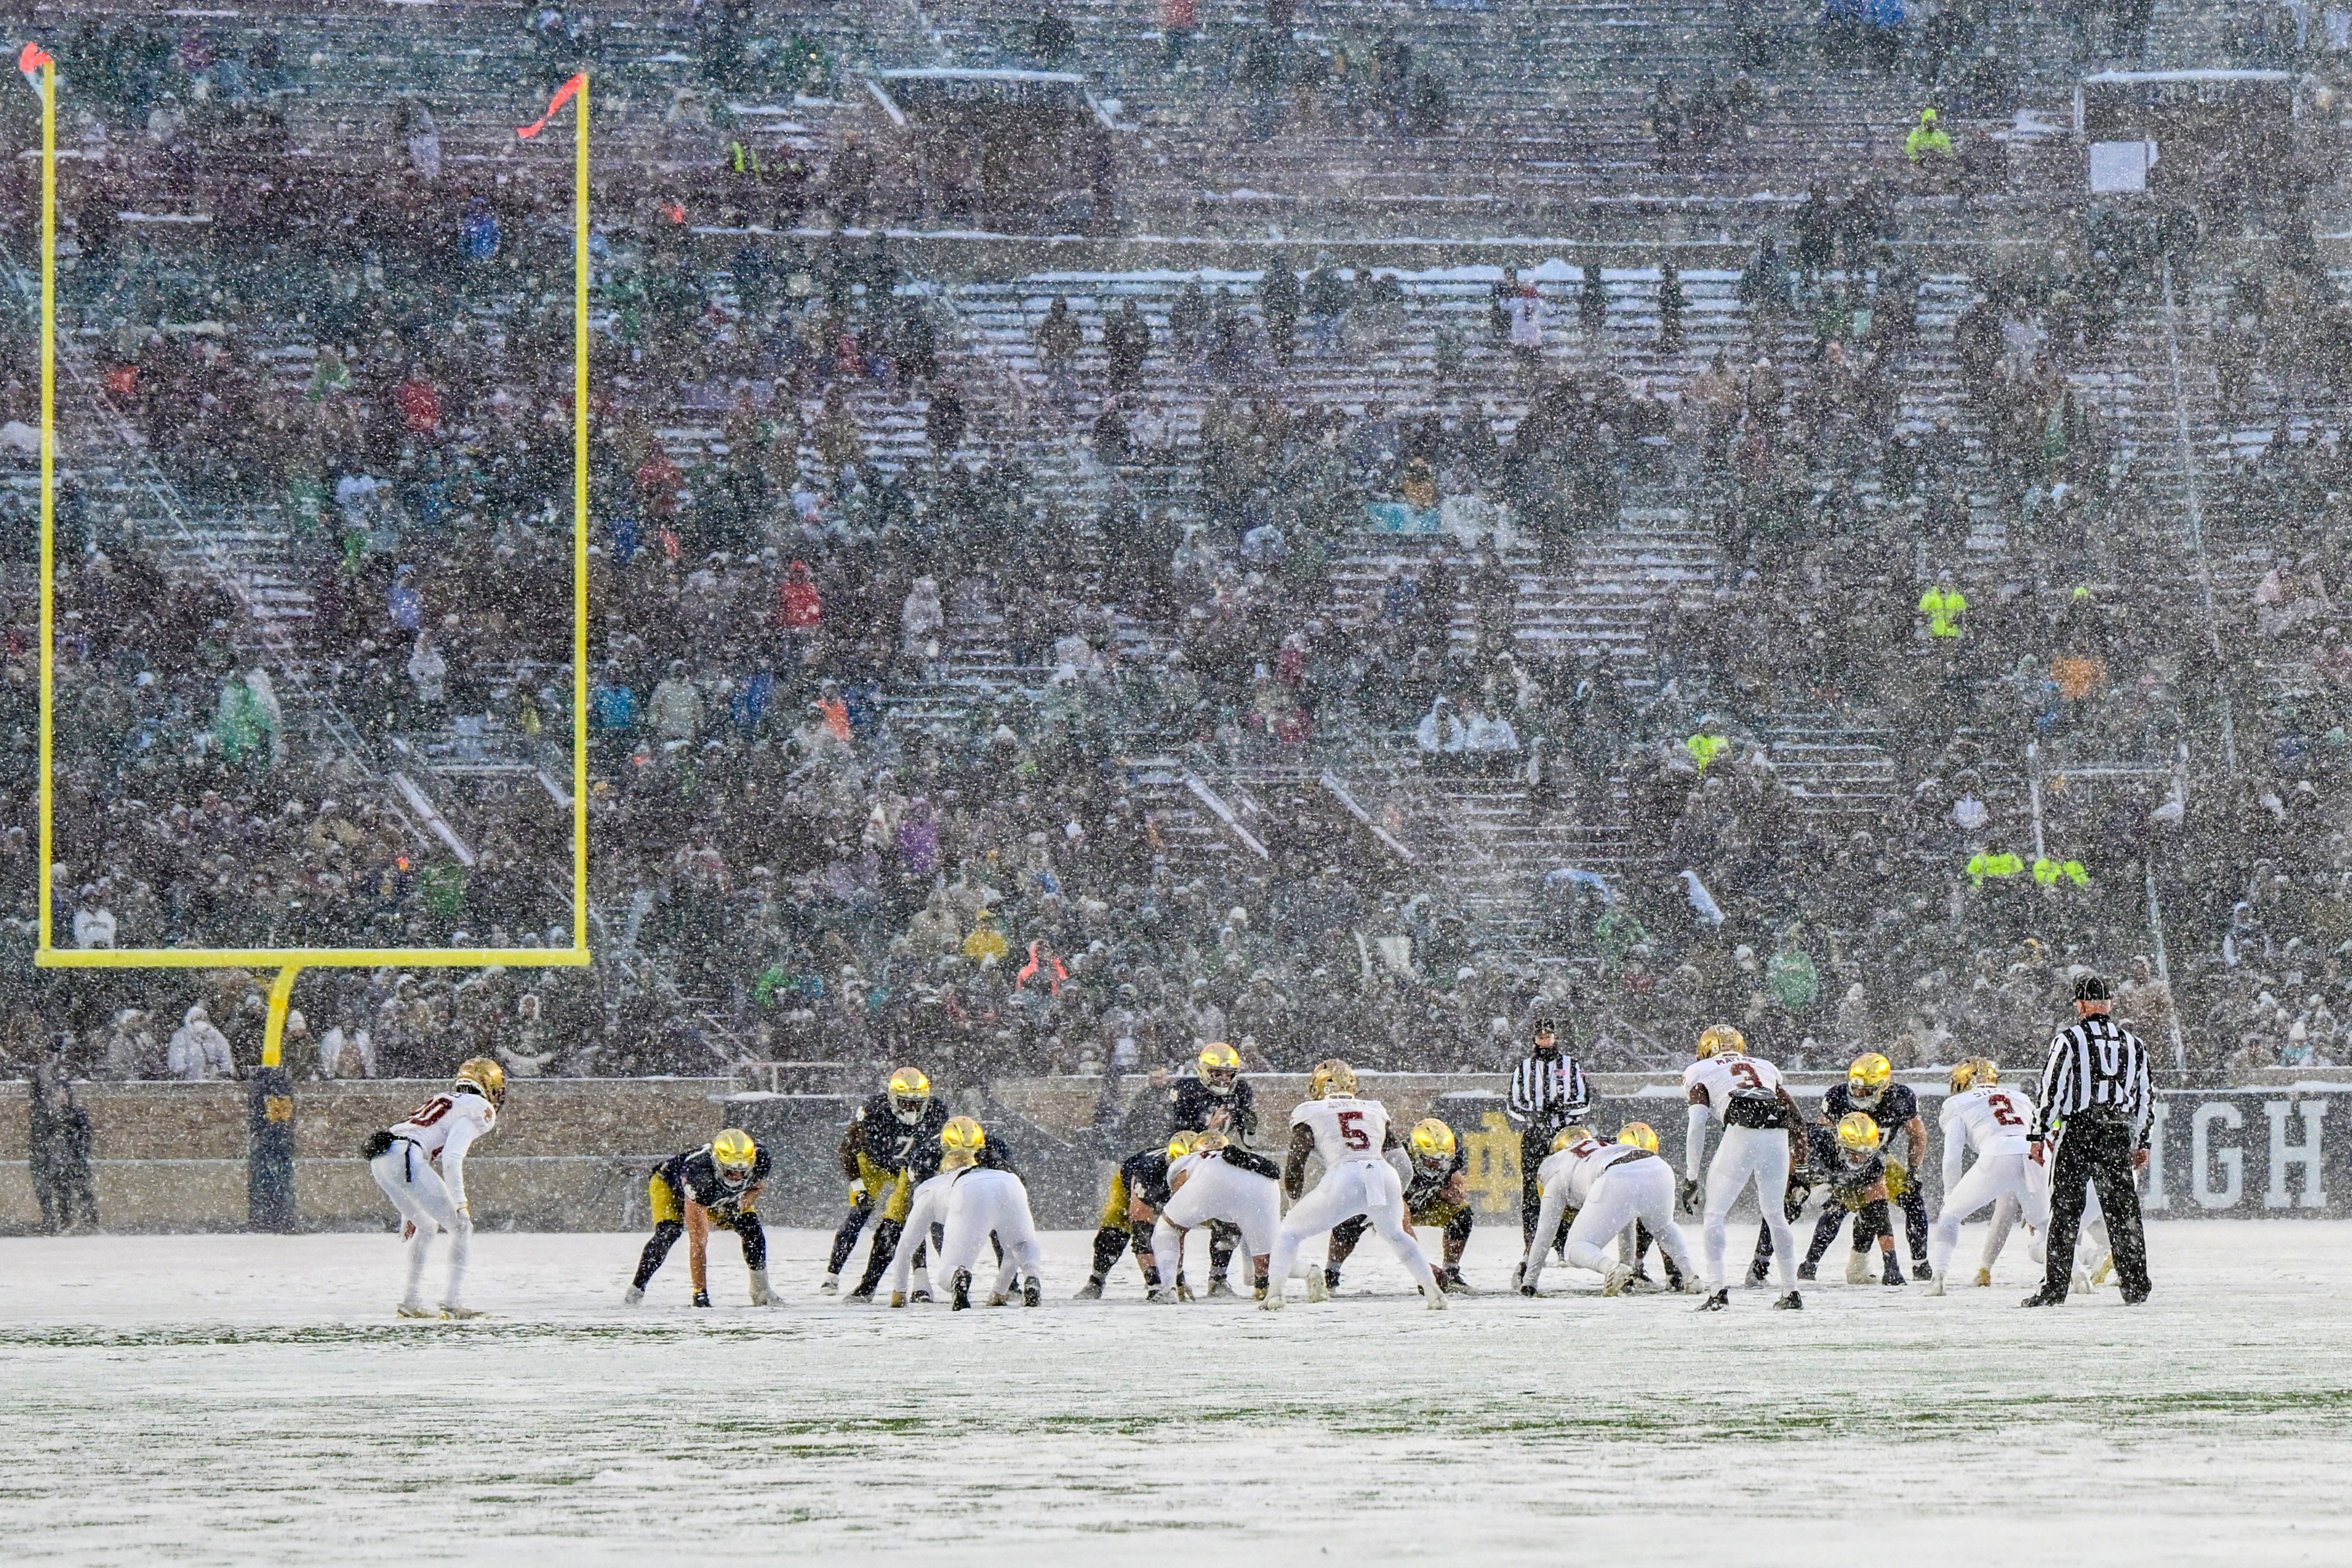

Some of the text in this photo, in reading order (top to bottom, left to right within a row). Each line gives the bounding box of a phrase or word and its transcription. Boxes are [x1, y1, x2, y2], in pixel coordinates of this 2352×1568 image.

[2094, 1039, 2120, 1076] U
[1730, 1063, 1763, 1087] 3
[1988, 1094, 2025, 1125] 2
[1337, 1111, 1370, 1151] 5
[893, 1135, 915, 1159] 7
